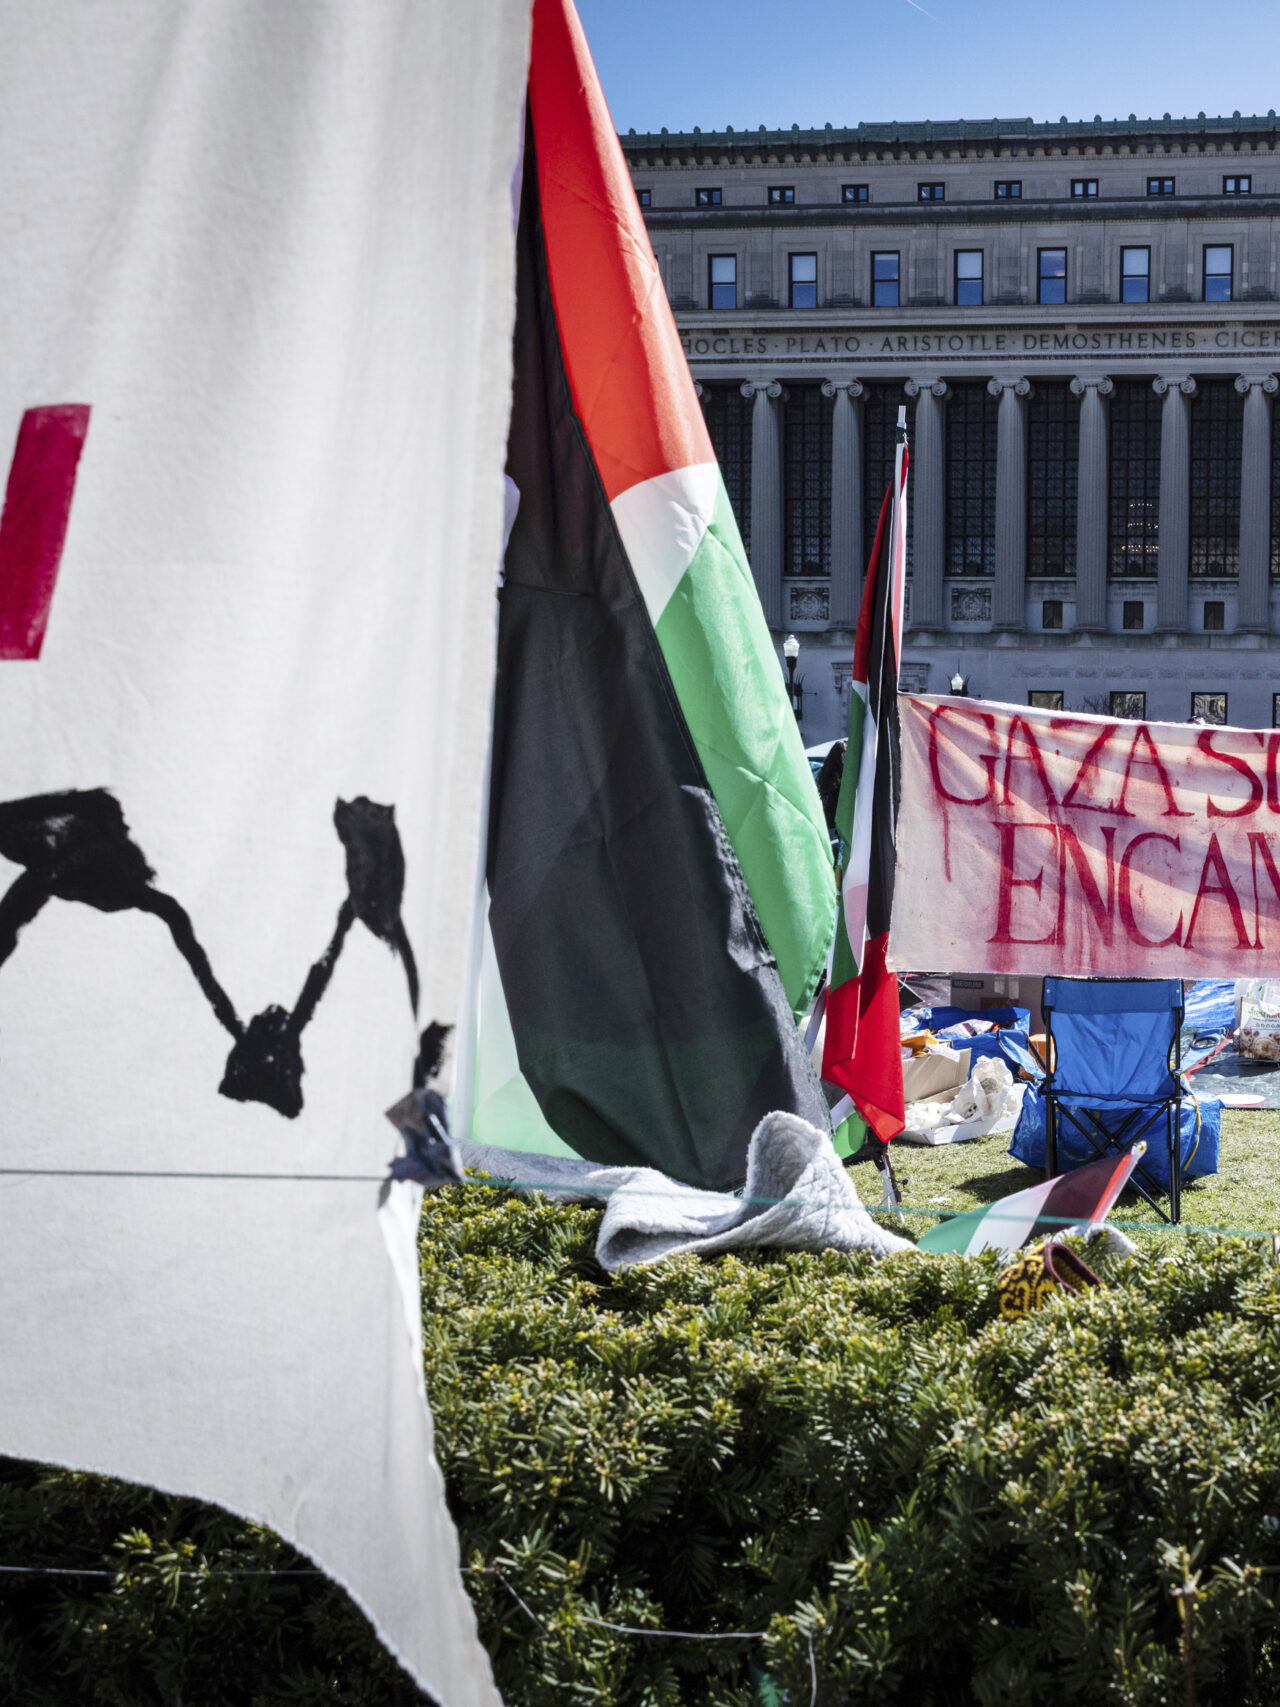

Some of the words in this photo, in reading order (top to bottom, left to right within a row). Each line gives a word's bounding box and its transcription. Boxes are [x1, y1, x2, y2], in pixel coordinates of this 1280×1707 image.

[786, 336, 860, 353] PLATO
[881, 334, 1006, 352] ARISTOTLE
[1023, 332, 1196, 351] DEMOSTHENES
[926, 703, 1194, 817] GAZA
